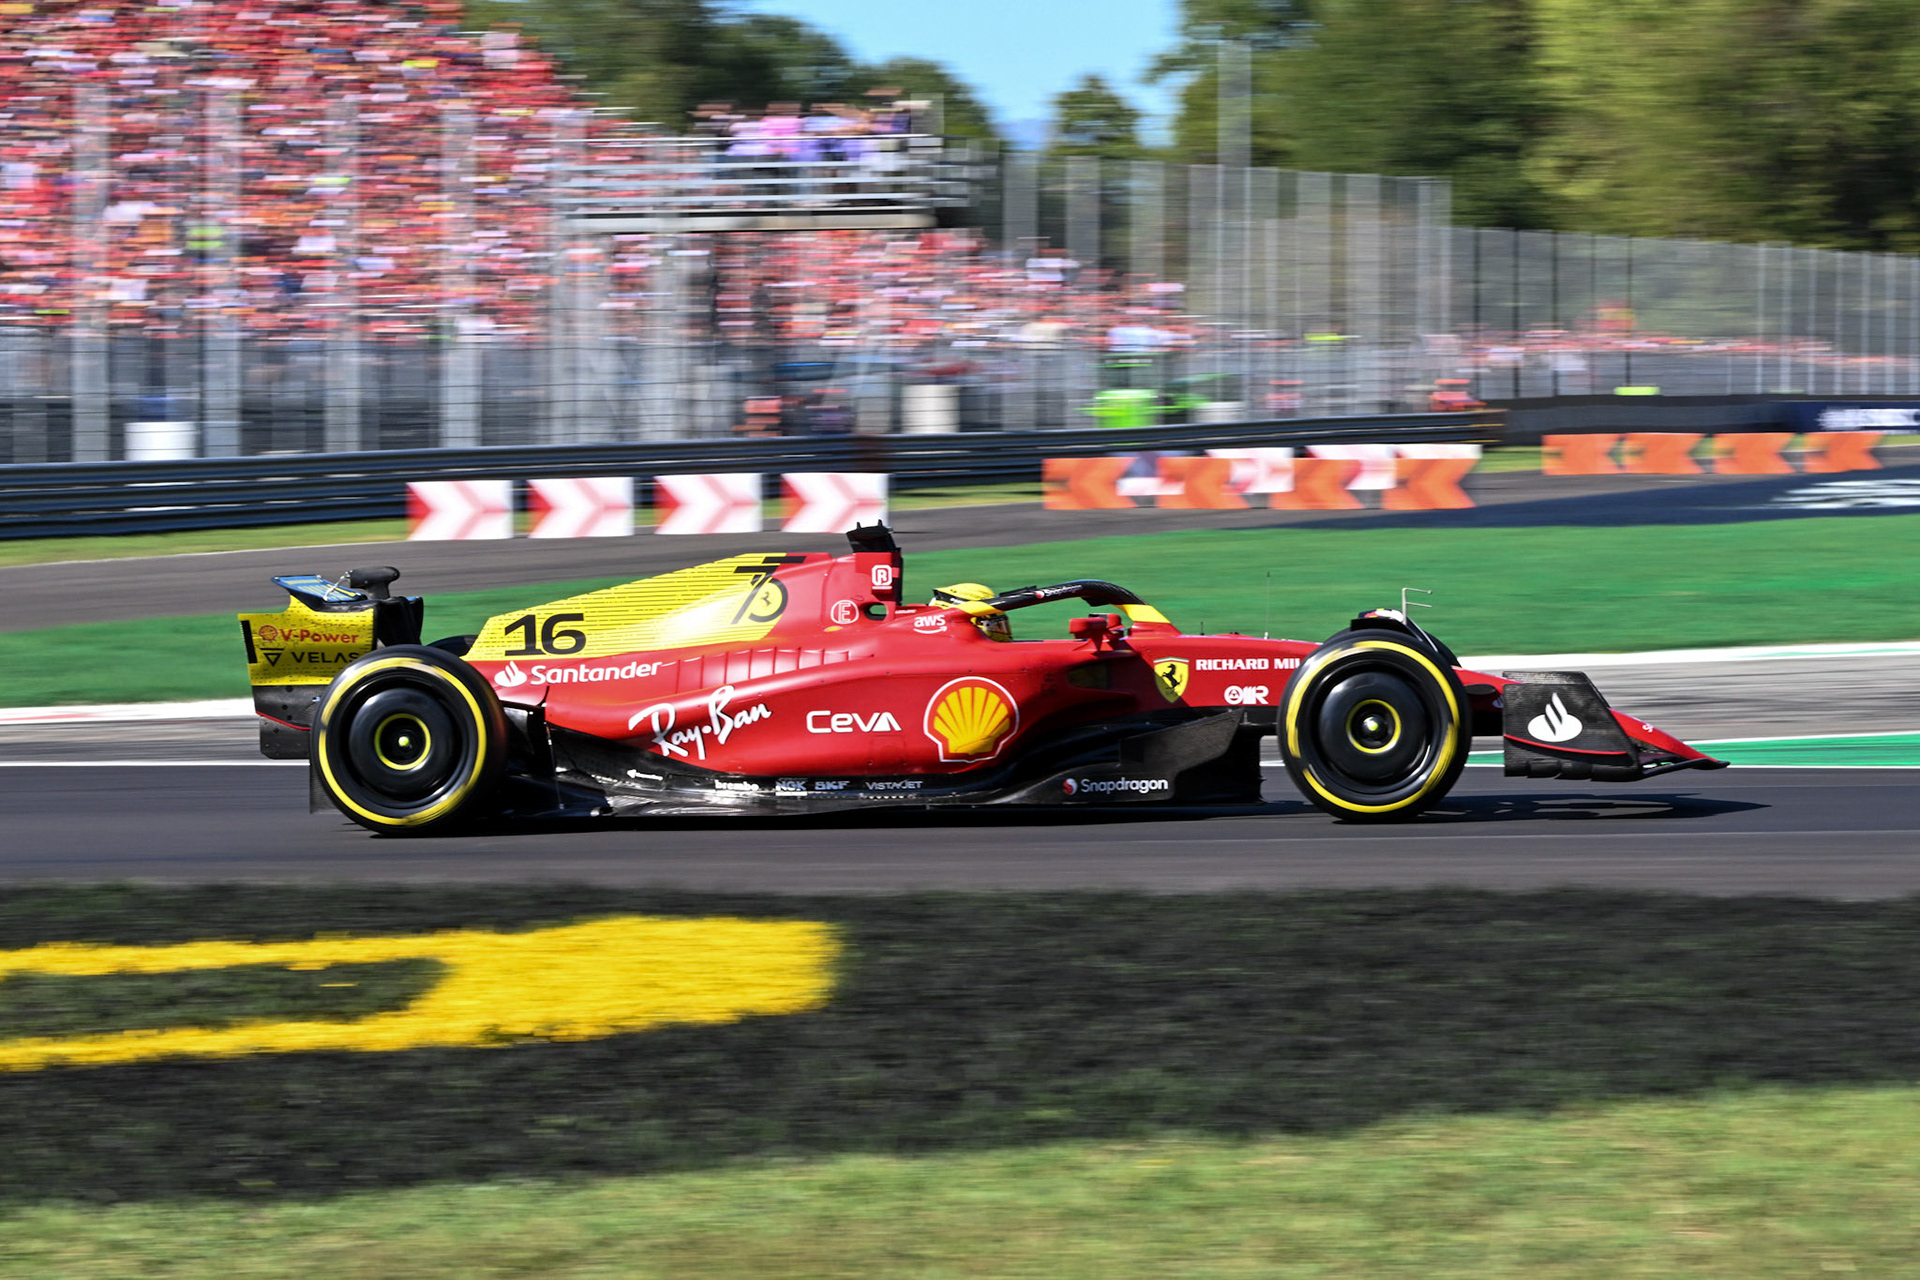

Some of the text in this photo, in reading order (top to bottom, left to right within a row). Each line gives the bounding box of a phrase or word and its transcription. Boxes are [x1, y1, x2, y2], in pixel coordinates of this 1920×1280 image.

[914, 614, 946, 628] aws
[280, 628, 359, 643] V-Power
[504, 613, 587, 656] 16
[1195, 658, 1270, 671] RICHARD
[530, 661, 663, 686] Santander
[628, 685, 772, 760] Ray-Ban
[714, 779, 760, 791] brembo
[775, 780, 807, 791] NGK
[814, 780, 850, 791] SKF
[1080, 776, 1169, 795] Snapdragon
